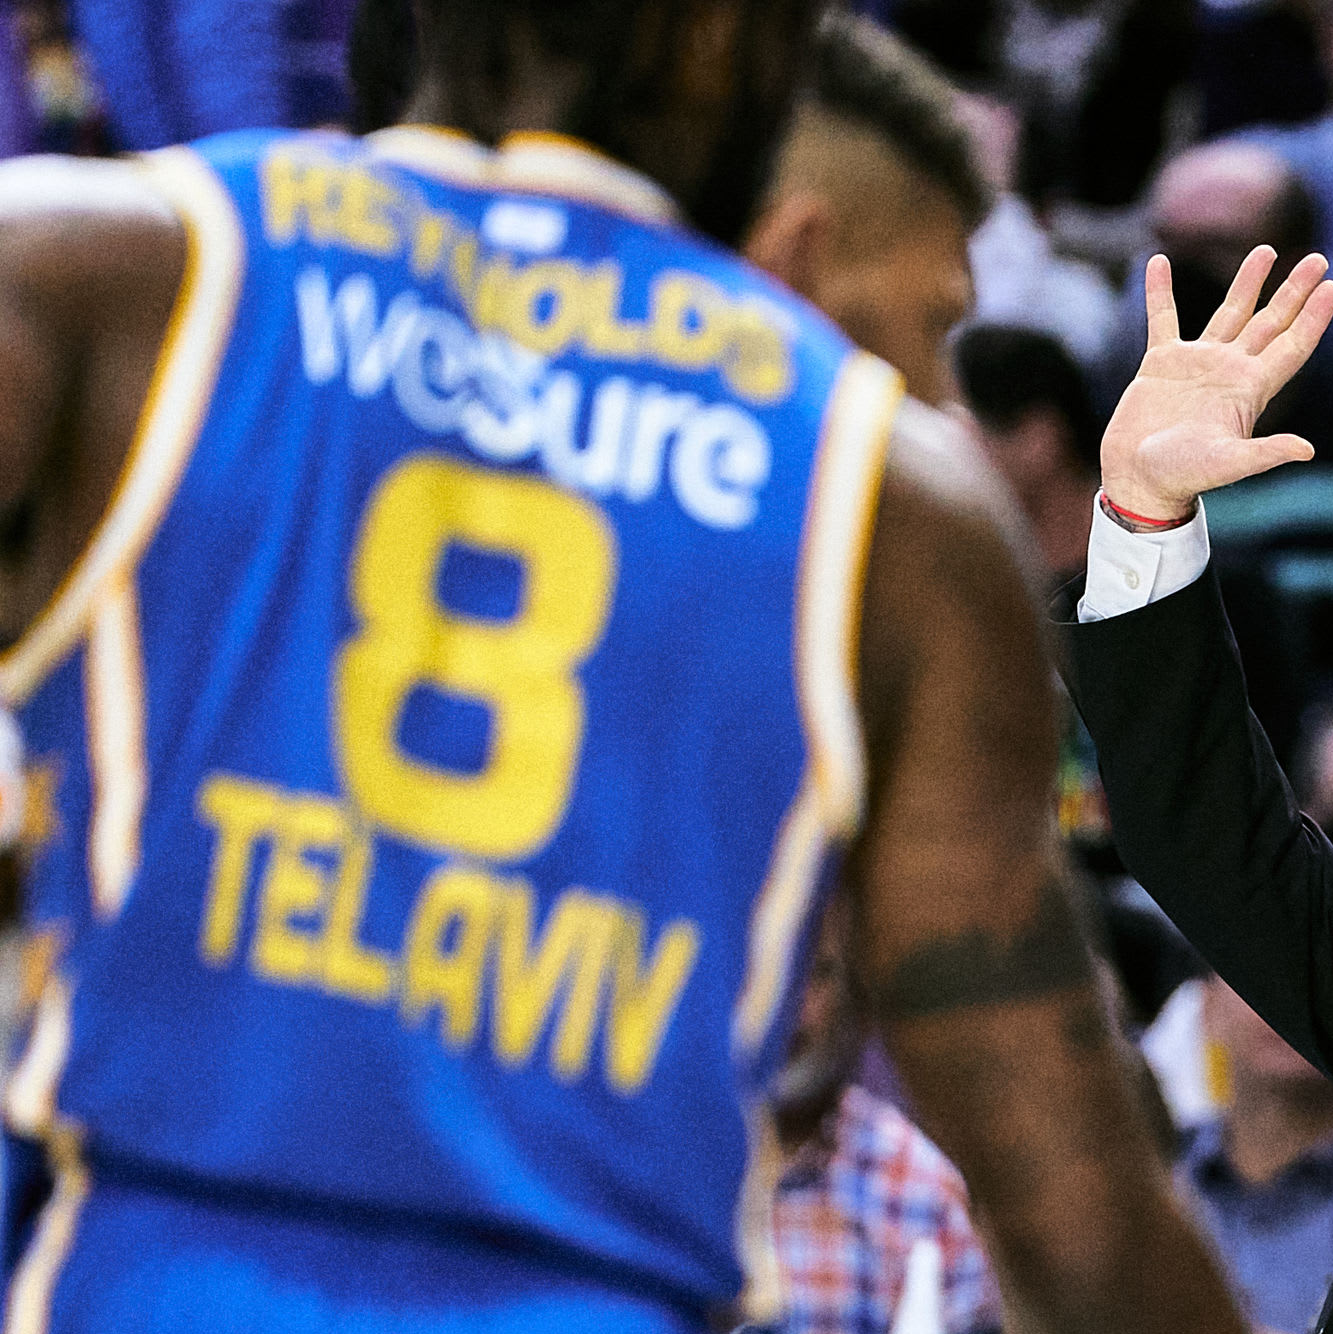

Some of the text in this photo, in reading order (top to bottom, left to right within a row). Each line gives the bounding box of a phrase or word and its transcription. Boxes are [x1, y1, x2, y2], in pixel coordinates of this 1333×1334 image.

[334, 455, 617, 864] 8
[198, 772, 700, 1096] TEL AVIV
